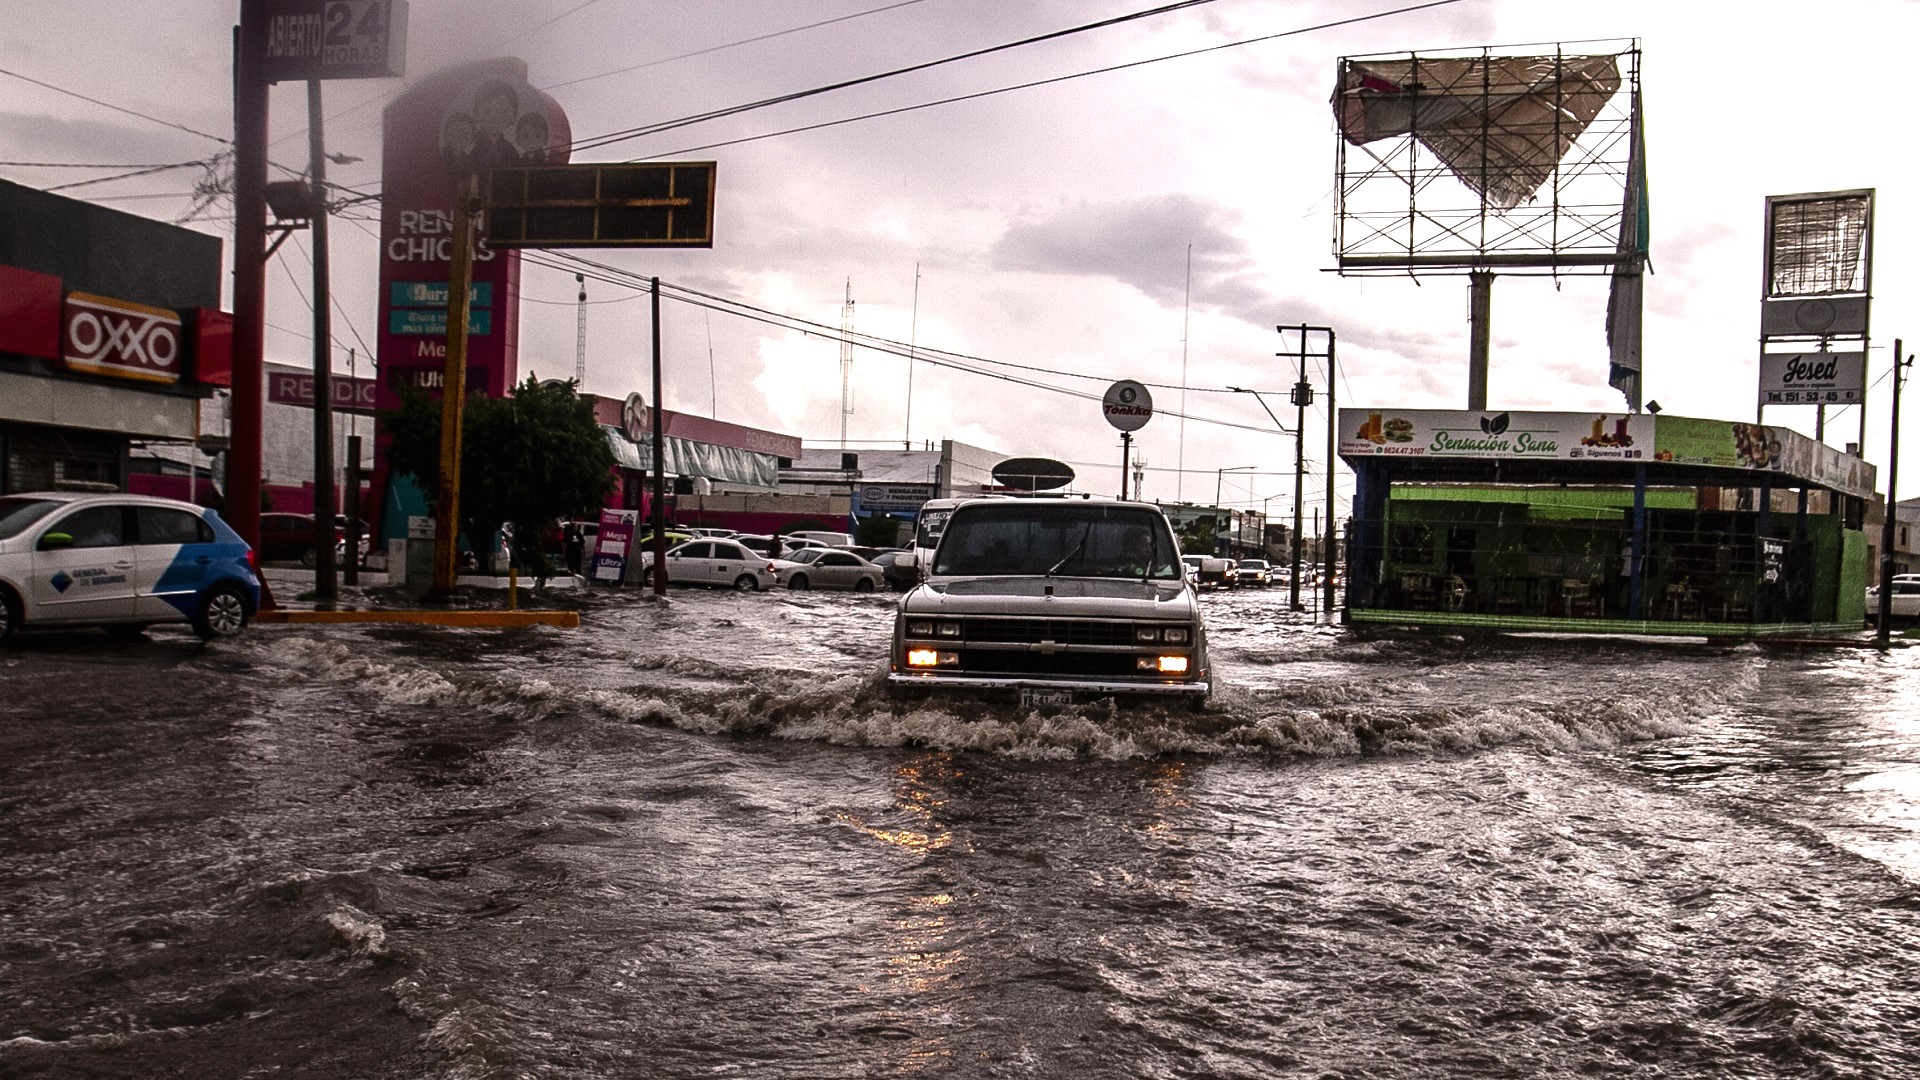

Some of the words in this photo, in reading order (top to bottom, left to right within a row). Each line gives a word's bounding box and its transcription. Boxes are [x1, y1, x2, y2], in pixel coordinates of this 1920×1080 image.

[266, 13, 320, 57] ABIERTO
[324, 2, 386, 45] 24
[323, 46, 383, 63] HORAS
[400, 209, 485, 234] RENI
[69, 312, 177, 367] OXXO
[1783, 355, 1838, 383] Jesed
[1767, 392, 1782, 402] Tel.
[1785, 392, 1800, 402] 151
[1807, 392, 1818, 401] 53
[1826, 392, 1838, 401] 45
[1430, 431, 1510, 453] Sensación
[1512, 432, 1559, 454] Sana
[606, 531, 627, 541] Mega
[600, 558, 621, 567] Ultra
